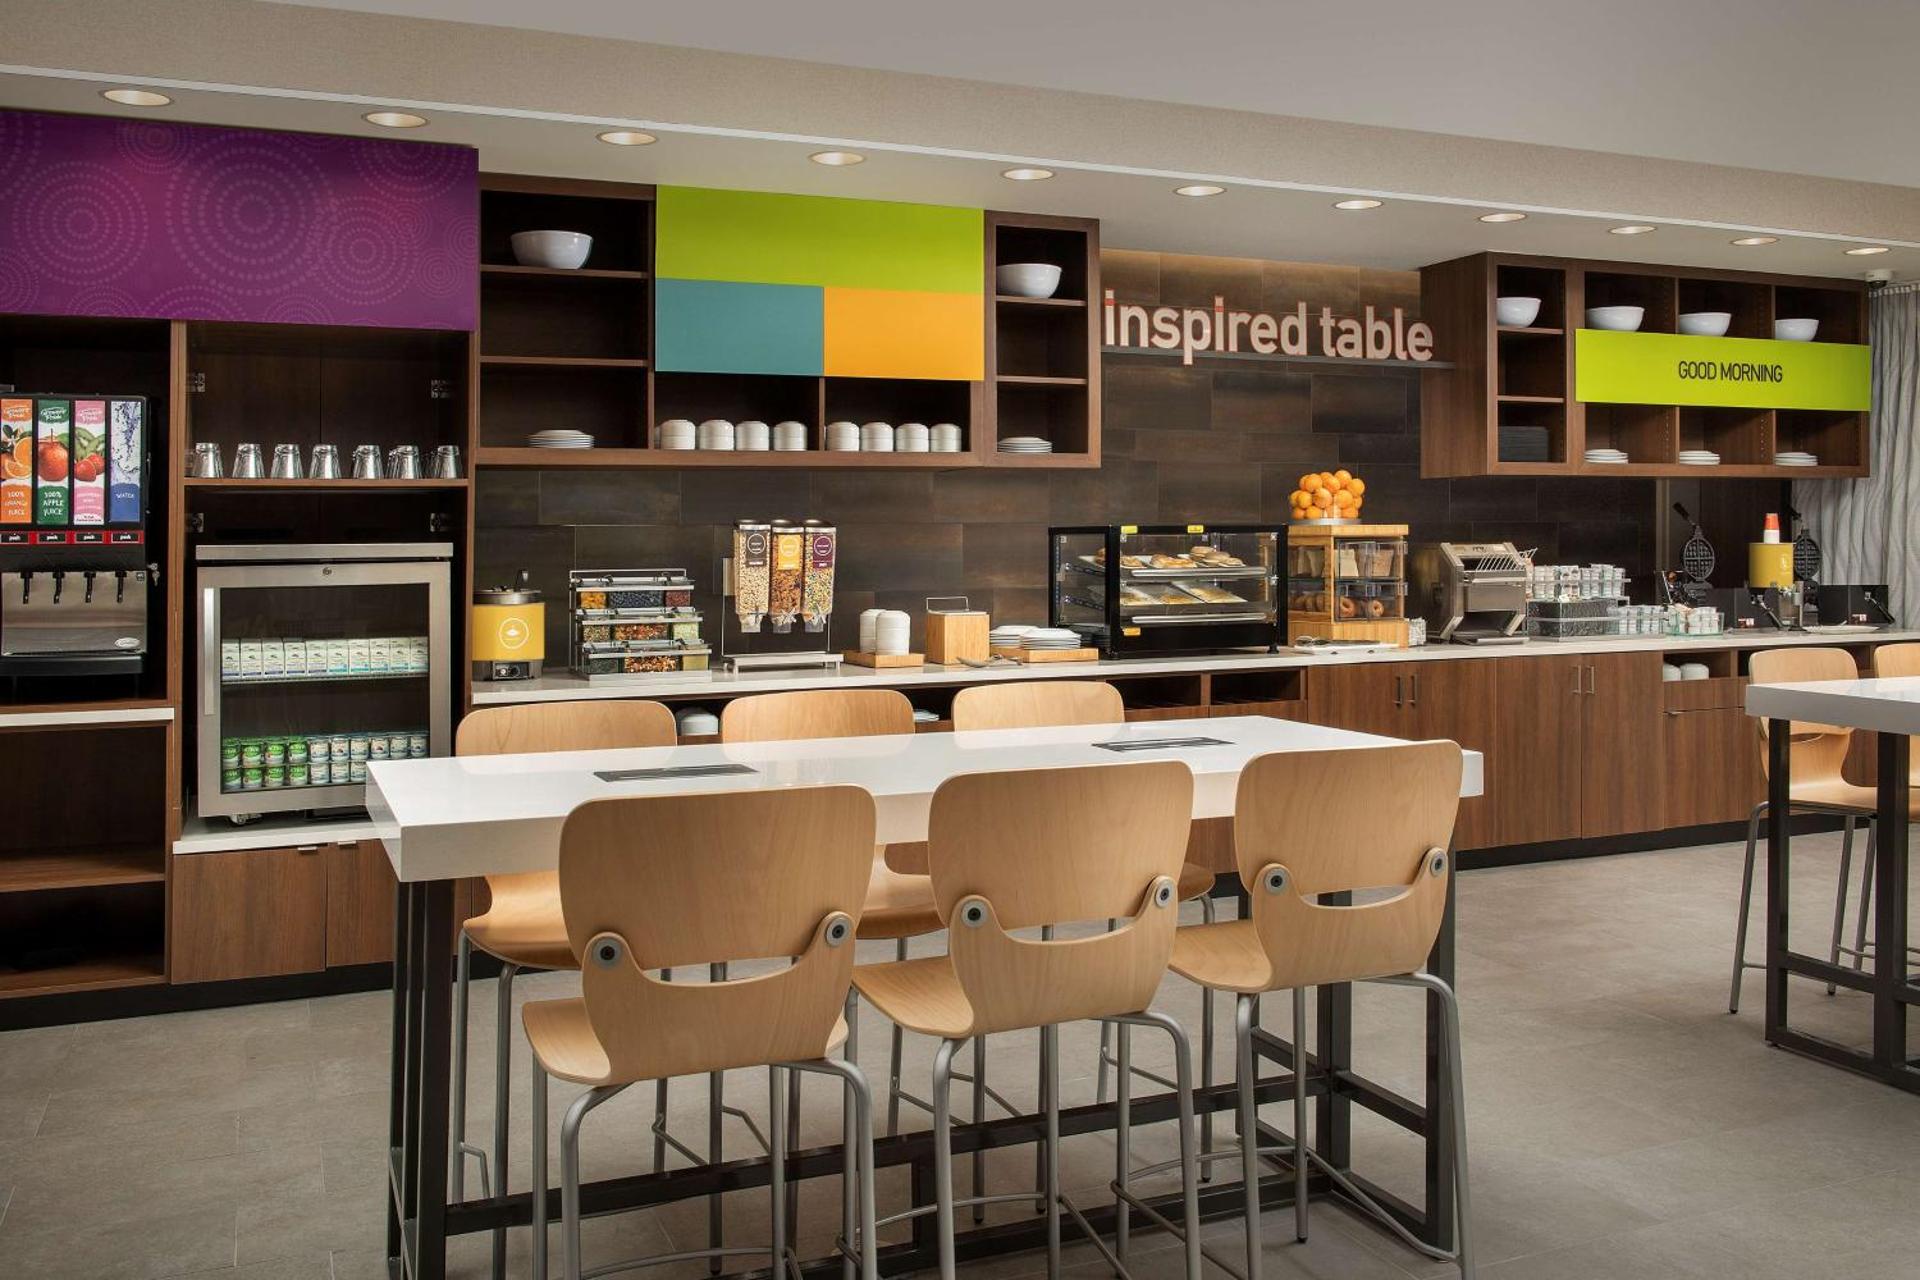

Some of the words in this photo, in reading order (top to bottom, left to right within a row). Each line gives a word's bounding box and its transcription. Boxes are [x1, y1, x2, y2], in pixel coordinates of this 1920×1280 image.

[1105, 288, 1307, 365] inspired
[1319, 305, 1433, 361] table
[1679, 360, 1717, 380] GOOD
[1721, 362, 1783, 383] MORNING
[43, 508, 63, 517] JUICE
